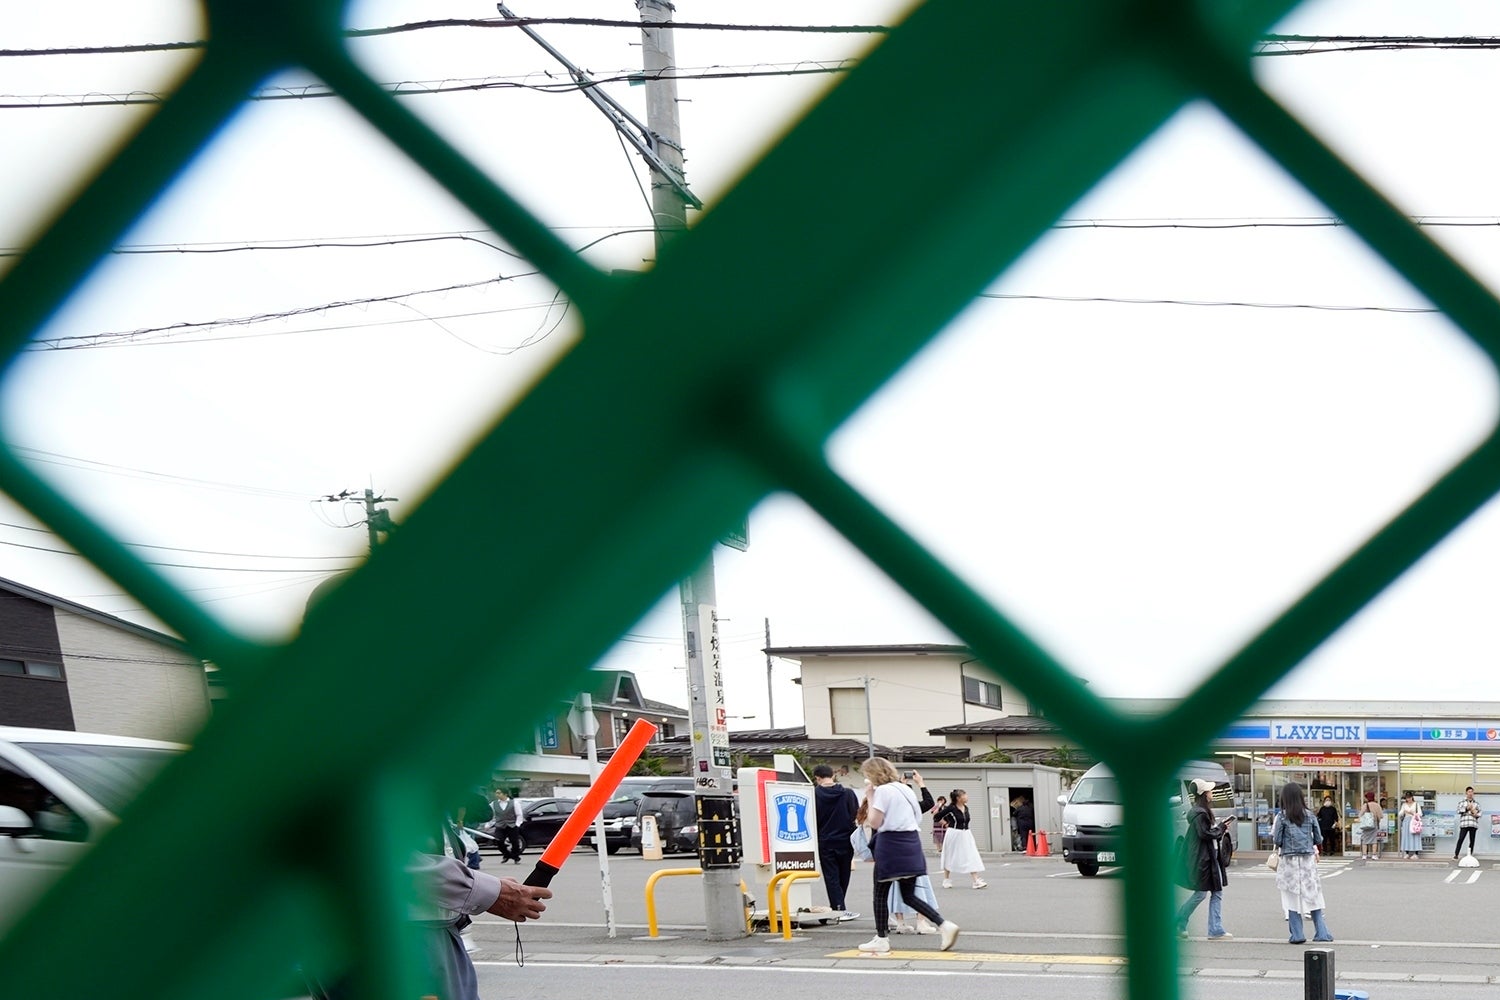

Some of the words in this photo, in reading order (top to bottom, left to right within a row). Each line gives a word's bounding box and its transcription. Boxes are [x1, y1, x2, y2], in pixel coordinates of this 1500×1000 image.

[1276, 725, 1360, 740] LAWSON
[1444, 730, 1463, 738] 野菜
[776, 794, 808, 807] LAWSON
[778, 831, 809, 840] STATION
[776, 861, 799, 870] MACHI
[800, 860, 814, 869] café
